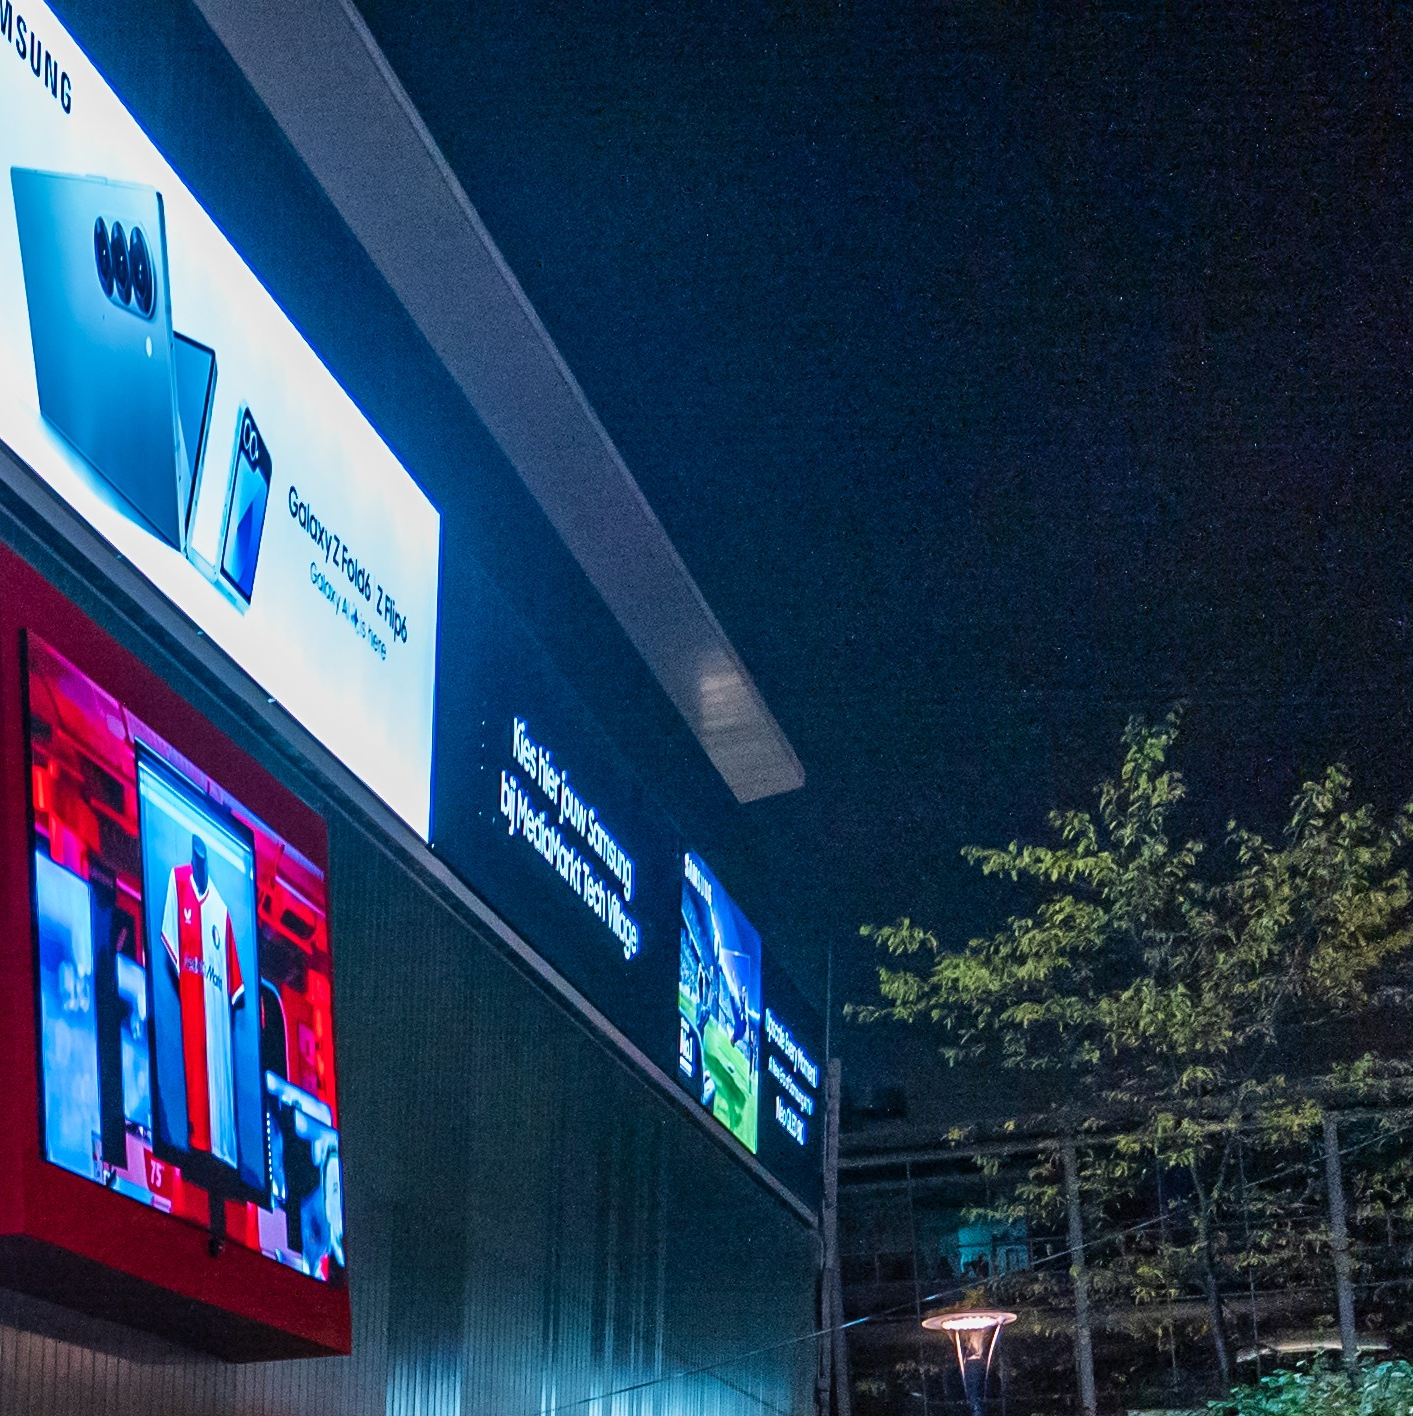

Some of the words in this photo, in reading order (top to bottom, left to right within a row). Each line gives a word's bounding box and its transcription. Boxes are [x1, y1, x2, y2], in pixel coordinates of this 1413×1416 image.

[288, 485, 332, 564] Galaxy
[332, 534, 341, 567] Z
[341, 544, 372, 602] Fold6
[376, 584, 384, 616] Z
[384, 594, 408, 644] Flip6
[500, 769, 518, 836] bij
[516, 788, 582, 896] MediaMarkt
[583, 861, 607, 923] Tech
[607, 889, 638, 961] Village
[512, 716, 537, 780] Kies
[537, 746, 561, 805] hier
[558, 770, 588, 838] jouw
[587, 806, 633, 902] Samsung
